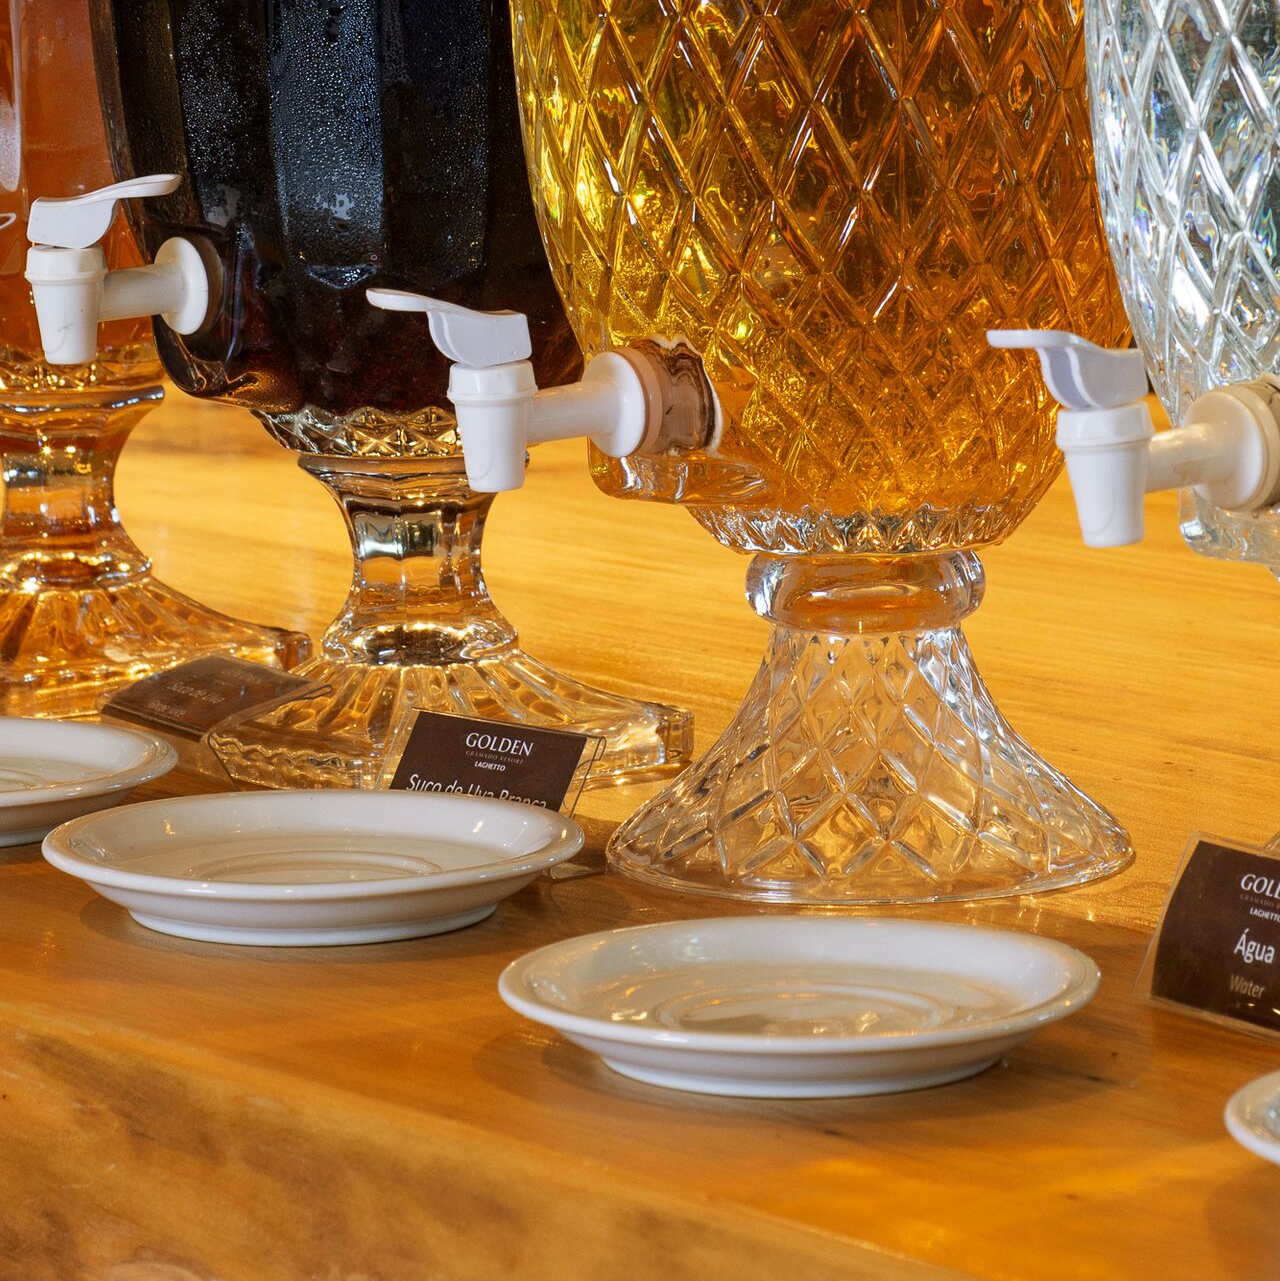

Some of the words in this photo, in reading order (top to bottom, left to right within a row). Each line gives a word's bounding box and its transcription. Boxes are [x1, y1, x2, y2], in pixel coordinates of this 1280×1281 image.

[465, 732, 535, 757] GOLDEN
[474, 760, 506, 772] LAGHETTO
[406, 774, 442, 792] Suco
[1233, 927, 1276, 965] Água
[1229, 974, 1266, 999] Water
